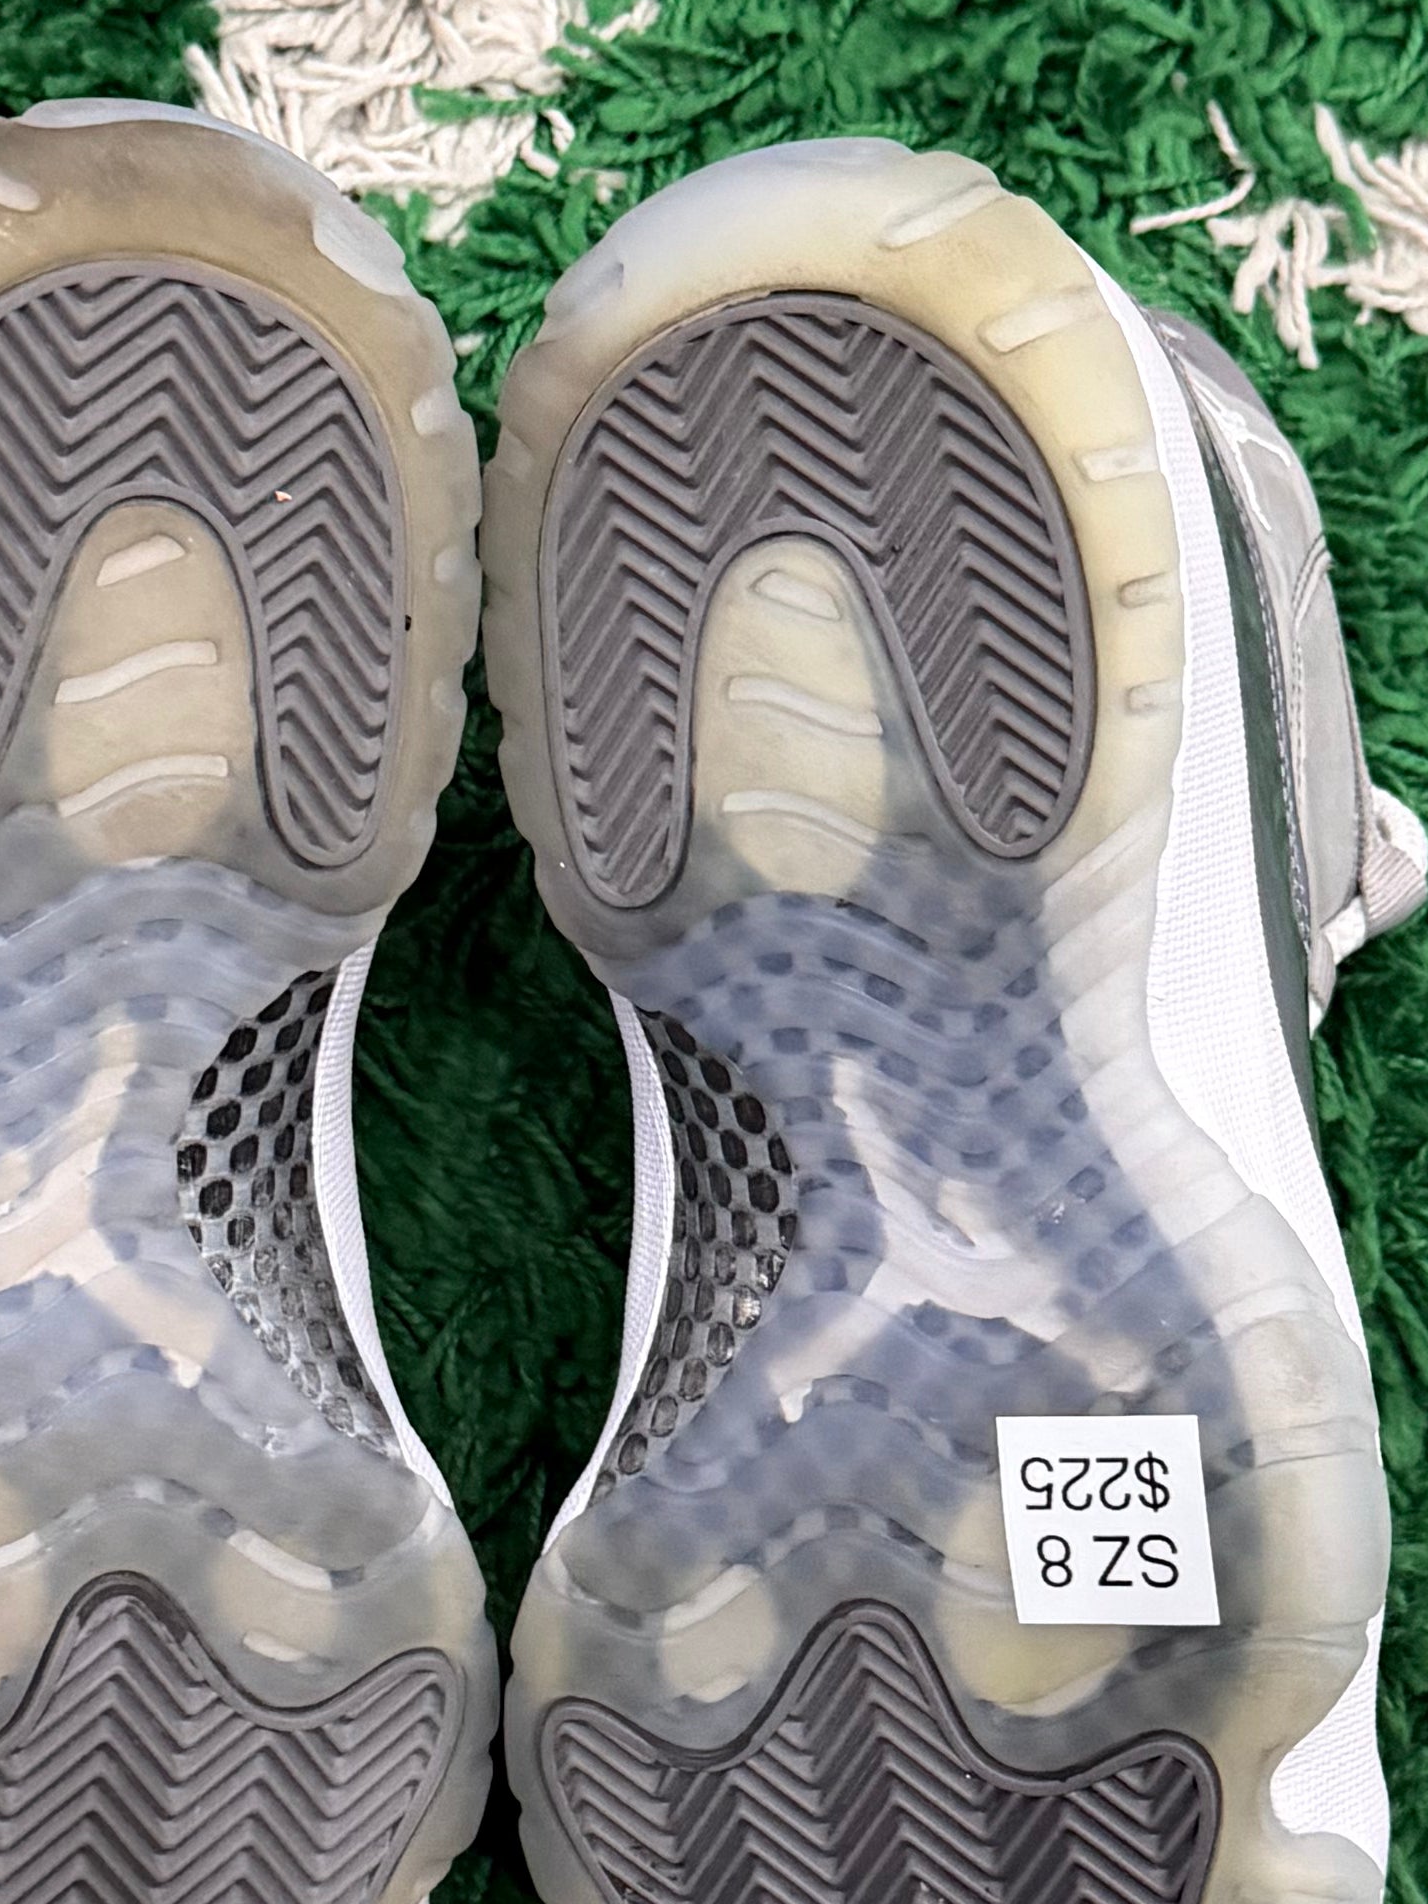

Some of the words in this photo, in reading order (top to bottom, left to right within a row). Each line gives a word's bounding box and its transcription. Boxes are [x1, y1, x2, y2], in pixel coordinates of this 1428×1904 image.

[1020, 1451, 1171, 1513] $225
[1036, 1534, 1073, 1588] 8
[1092, 1534, 1179, 1589] SZ
